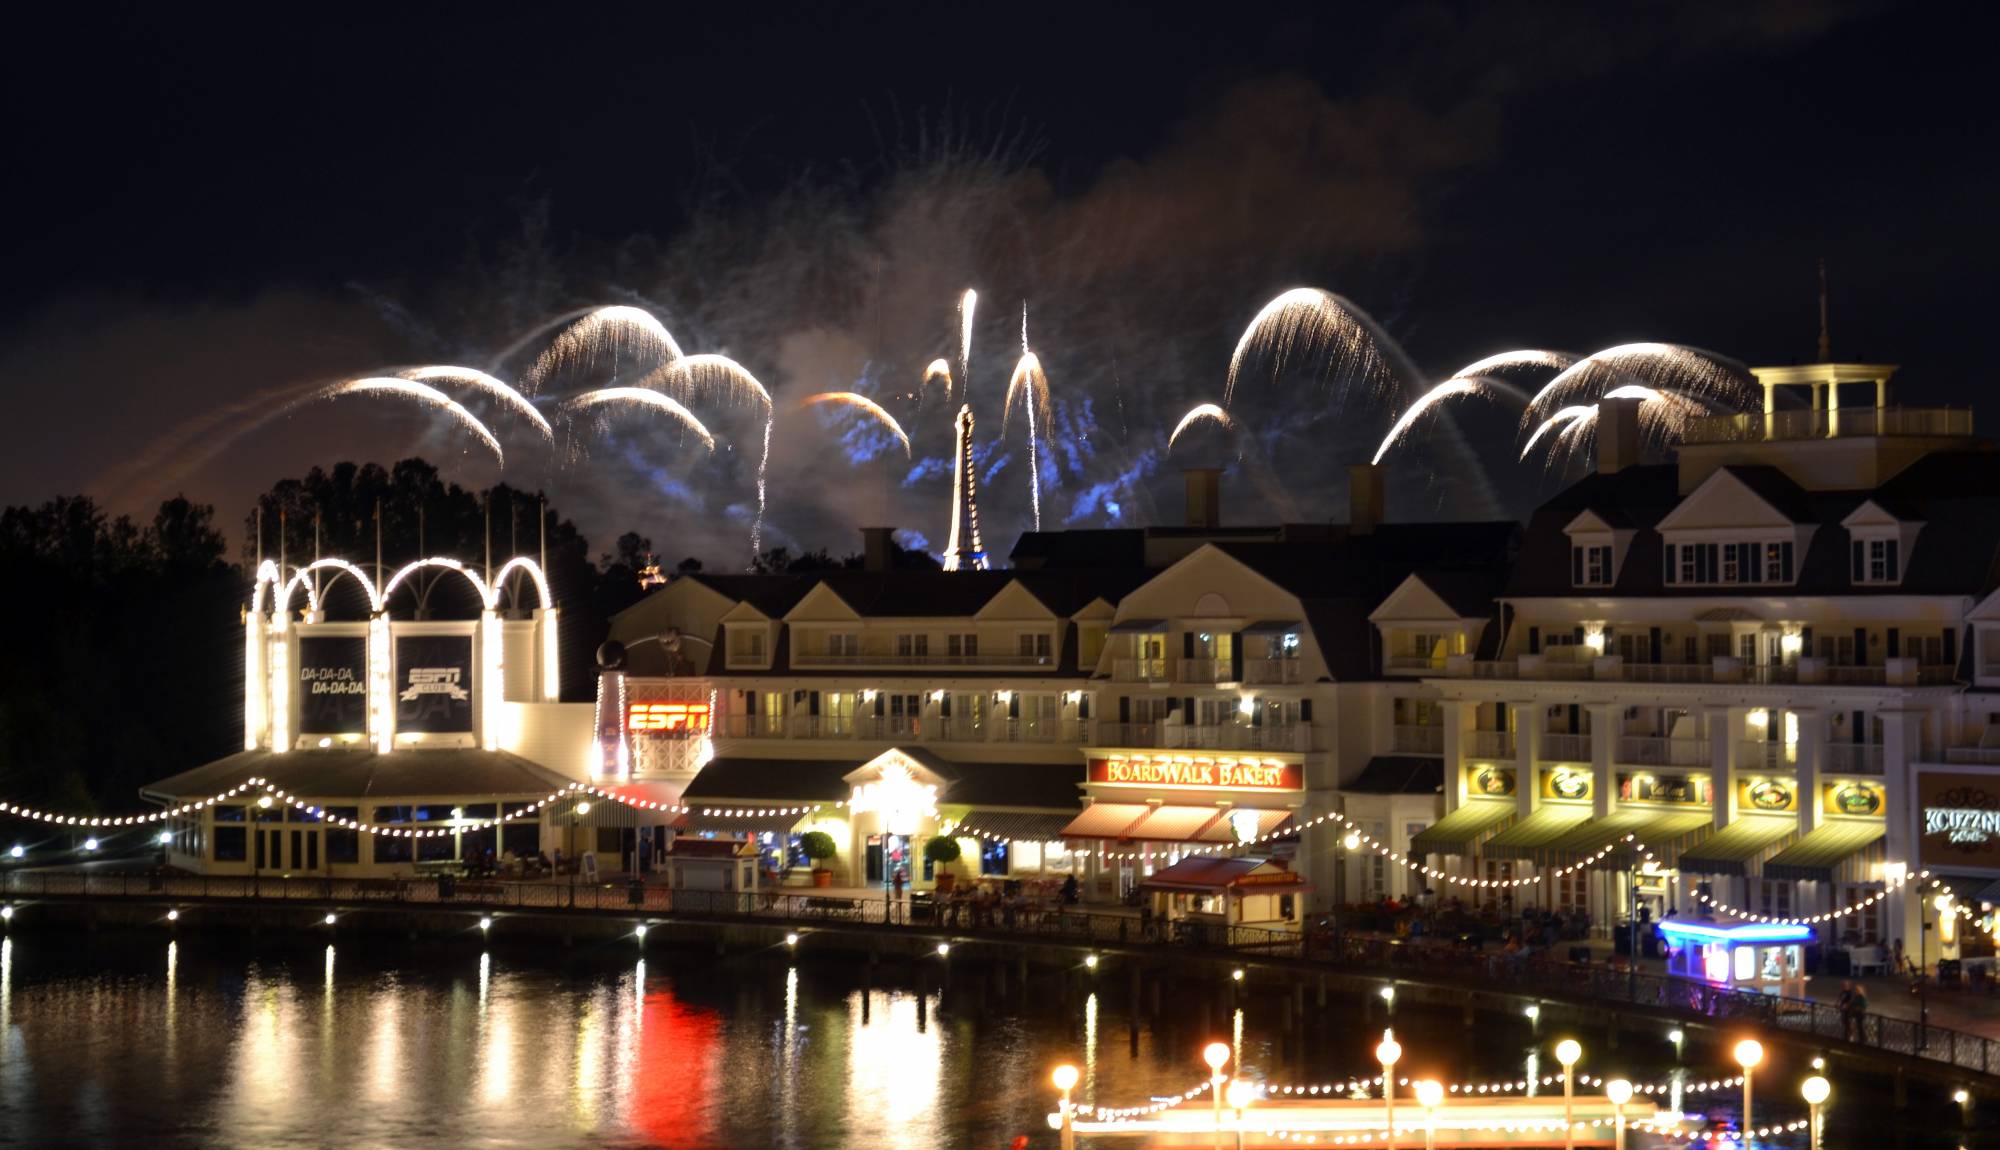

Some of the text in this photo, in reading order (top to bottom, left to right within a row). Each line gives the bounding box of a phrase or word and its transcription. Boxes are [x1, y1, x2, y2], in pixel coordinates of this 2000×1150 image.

[408, 668, 460, 684] ESPN
[628, 704, 708, 729] ESPN
[1107, 761, 1284, 786] BOARDWALK BAKERY
